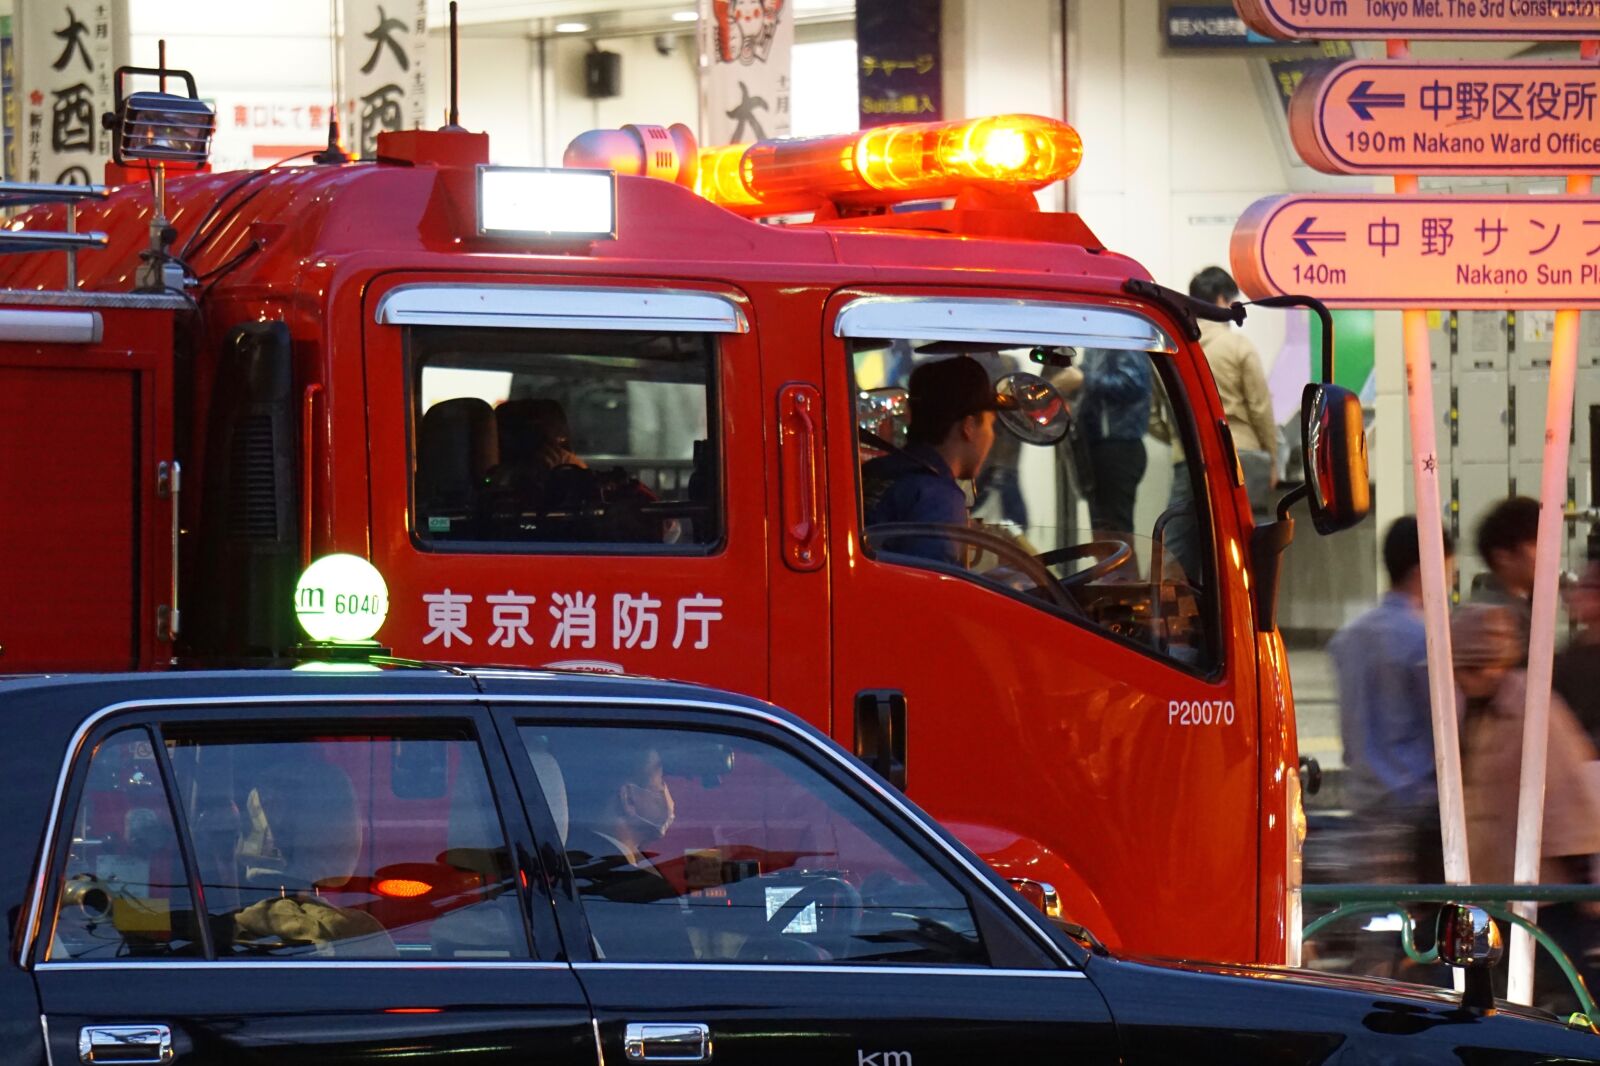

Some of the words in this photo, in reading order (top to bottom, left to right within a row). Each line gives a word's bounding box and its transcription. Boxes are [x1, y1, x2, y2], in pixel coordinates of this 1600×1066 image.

[1289, 0, 1348, 17] 190m
[1364, 0, 1408, 21] Tokyo
[1412, 0, 1443, 17] Met.
[1447, 0, 1476, 17] The
[1480, 0, 1505, 17] 3rd
[1420, 79, 1598, 121] 中野区役所
[1346, 131, 1405, 153] 190m
[1413, 132, 1484, 153] Nakano
[1491, 133, 1541, 154] Ward
[1547, 133, 1600, 154] Office
[1293, 264, 1346, 285] 140m
[1456, 264, 1528, 285] Nakano
[1537, 264, 1572, 285] Sun
[1581, 264, 1600, 285] Pl
[335, 594, 380, 615] 6040
[422, 587, 724, 650] 東京消防庁
[1168, 700, 1235, 726] P20070
[857, 1049, 913, 1066] km
